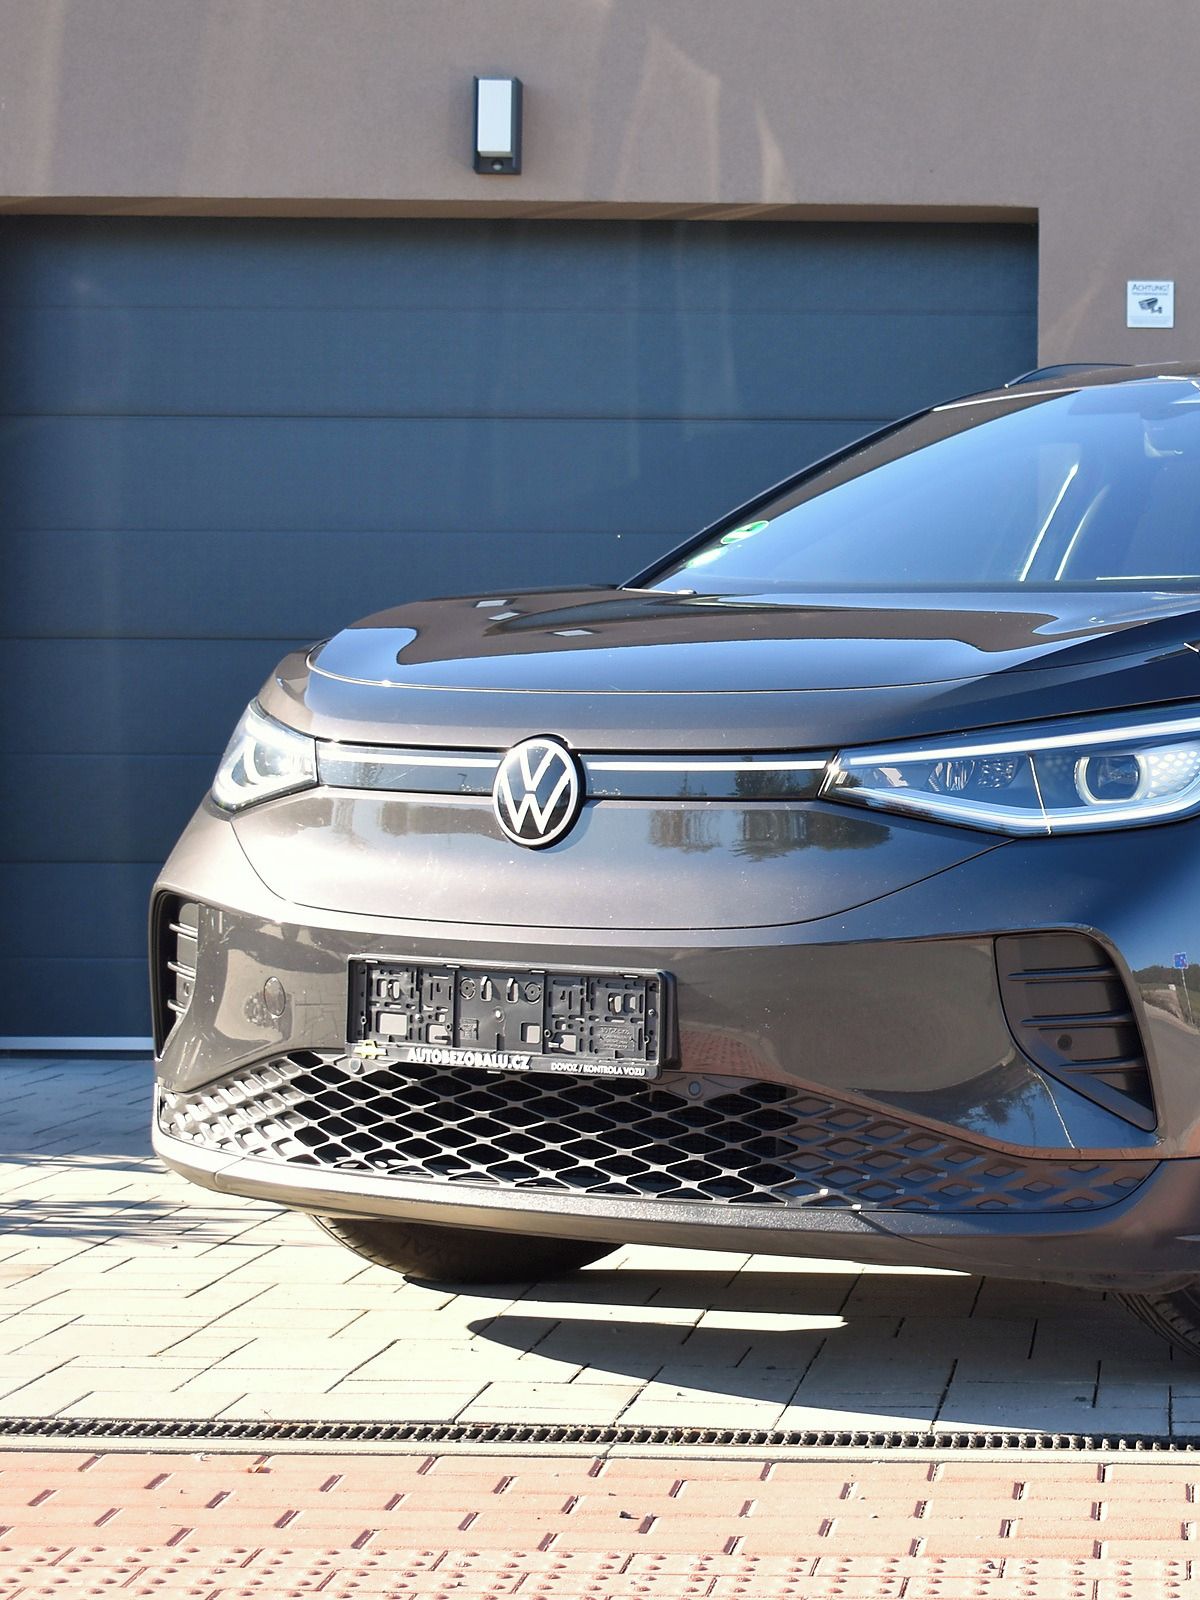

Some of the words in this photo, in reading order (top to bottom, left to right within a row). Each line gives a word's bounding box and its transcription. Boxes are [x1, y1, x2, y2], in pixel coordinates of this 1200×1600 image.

[496, 742, 575, 842] VW
[406, 1047, 531, 1070] AUTOBEZOBALU.CZ
[550, 1062, 578, 1073] DOVOZ
[583, 1064, 623, 1075] KONTROLA
[623, 1066, 646, 1077] VOZU
